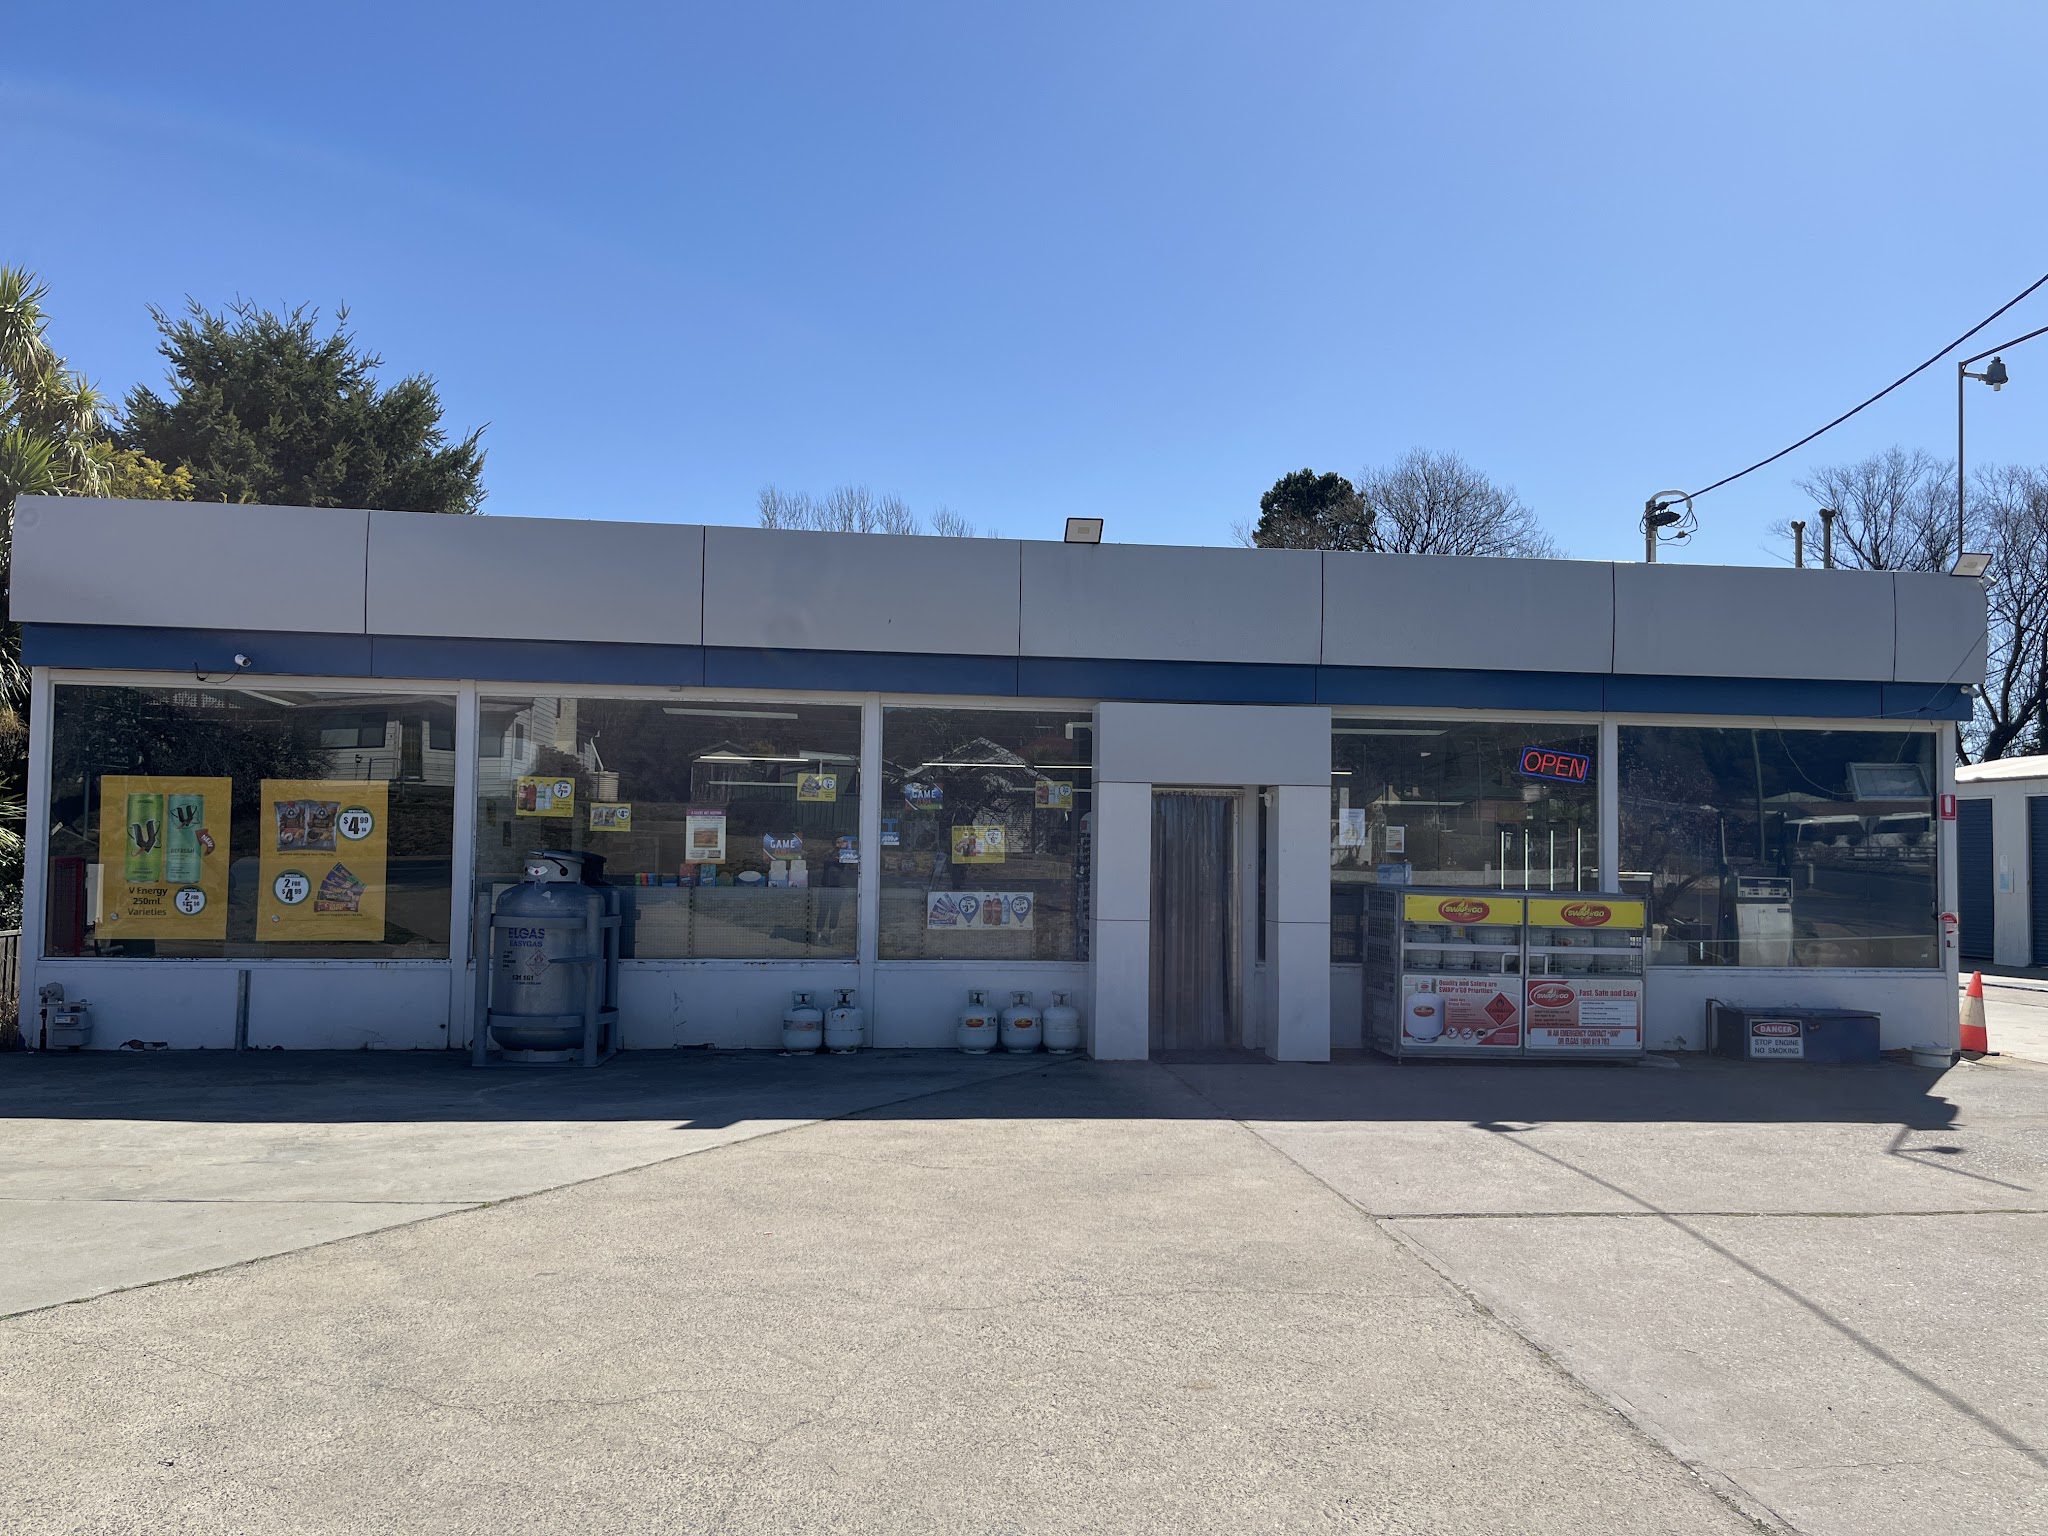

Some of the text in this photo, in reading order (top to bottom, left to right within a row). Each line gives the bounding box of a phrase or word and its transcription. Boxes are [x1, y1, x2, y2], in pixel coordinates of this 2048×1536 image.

[1524, 751, 1586, 779] OPEN
[911, 789, 936, 799] GAME
[770, 839, 796, 849] GAME
[284, 878, 291, 888] 2
[128, 887, 168, 897] V Energy
[184, 892, 190, 900] 2
[127, 908, 167, 917] Varieties
[508, 927, 545, 939] ELGAS
[509, 940, 543, 948] EASYGAS
[1438, 979, 1457, 988] Quality
[1470, 980, 1488, 988] Safety
[1594, 989, 1609, 997] Safe
[1610, 989, 1622, 997] and
[1622, 989, 1637, 998] Easy
[1760, 1025, 1793, 1033] DANGER
[1565, 1037, 1579, 1045] ELGAS
[1767, 1047, 1800, 1055] SMOKING
